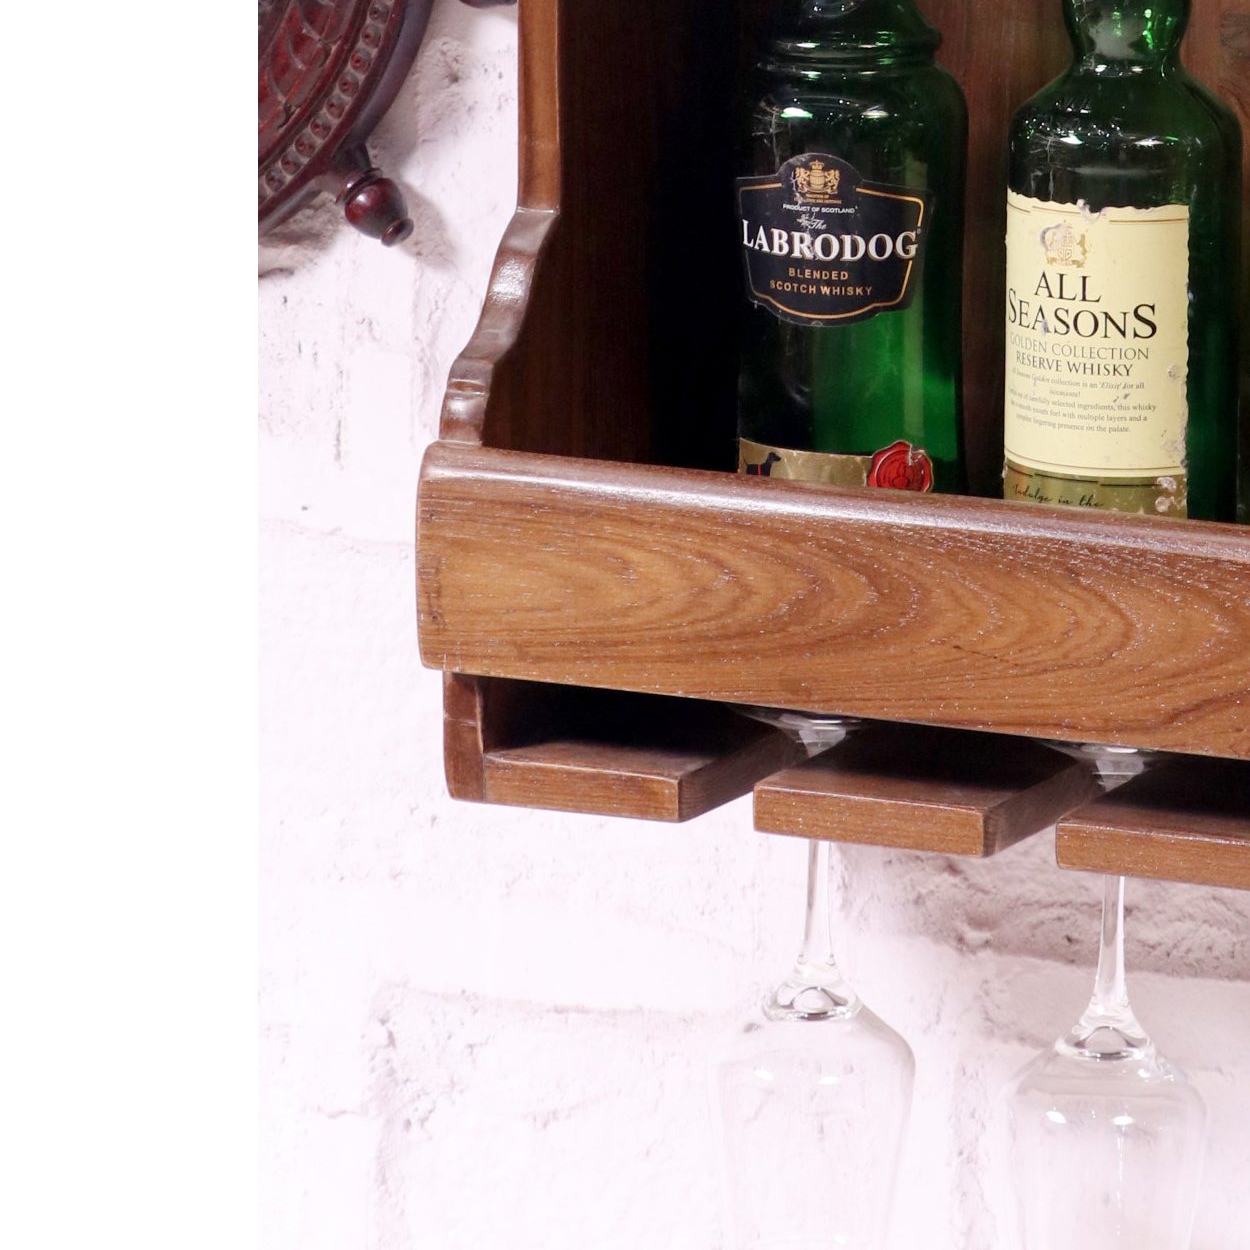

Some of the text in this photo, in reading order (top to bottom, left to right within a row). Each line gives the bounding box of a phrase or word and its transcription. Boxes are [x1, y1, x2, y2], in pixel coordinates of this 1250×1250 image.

[782, 203, 810, 212] PRODUCT
[821, 206, 856, 214] SCOTLAND
[742, 218, 919, 262] LABRODOG
[788, 267, 849, 281] BLENDED
[769, 279, 873, 296] SCOTCH WHISKY
[1033, 270, 1102, 303] ALL
[1007, 287, 1158, 340] SEASONS
[1010, 332, 1150, 361] GOLDEN COLLECTION
[1016, 349, 1063, 373] RESERVE
[1067, 360, 1134, 378] WHISKY
[1136, 381, 1145, 390] all
[1117, 404, 1130, 412] this
[1132, 402, 1157, 412] whisky
[1057, 495, 1074, 506] in
[1078, 494, 1104, 508] the
